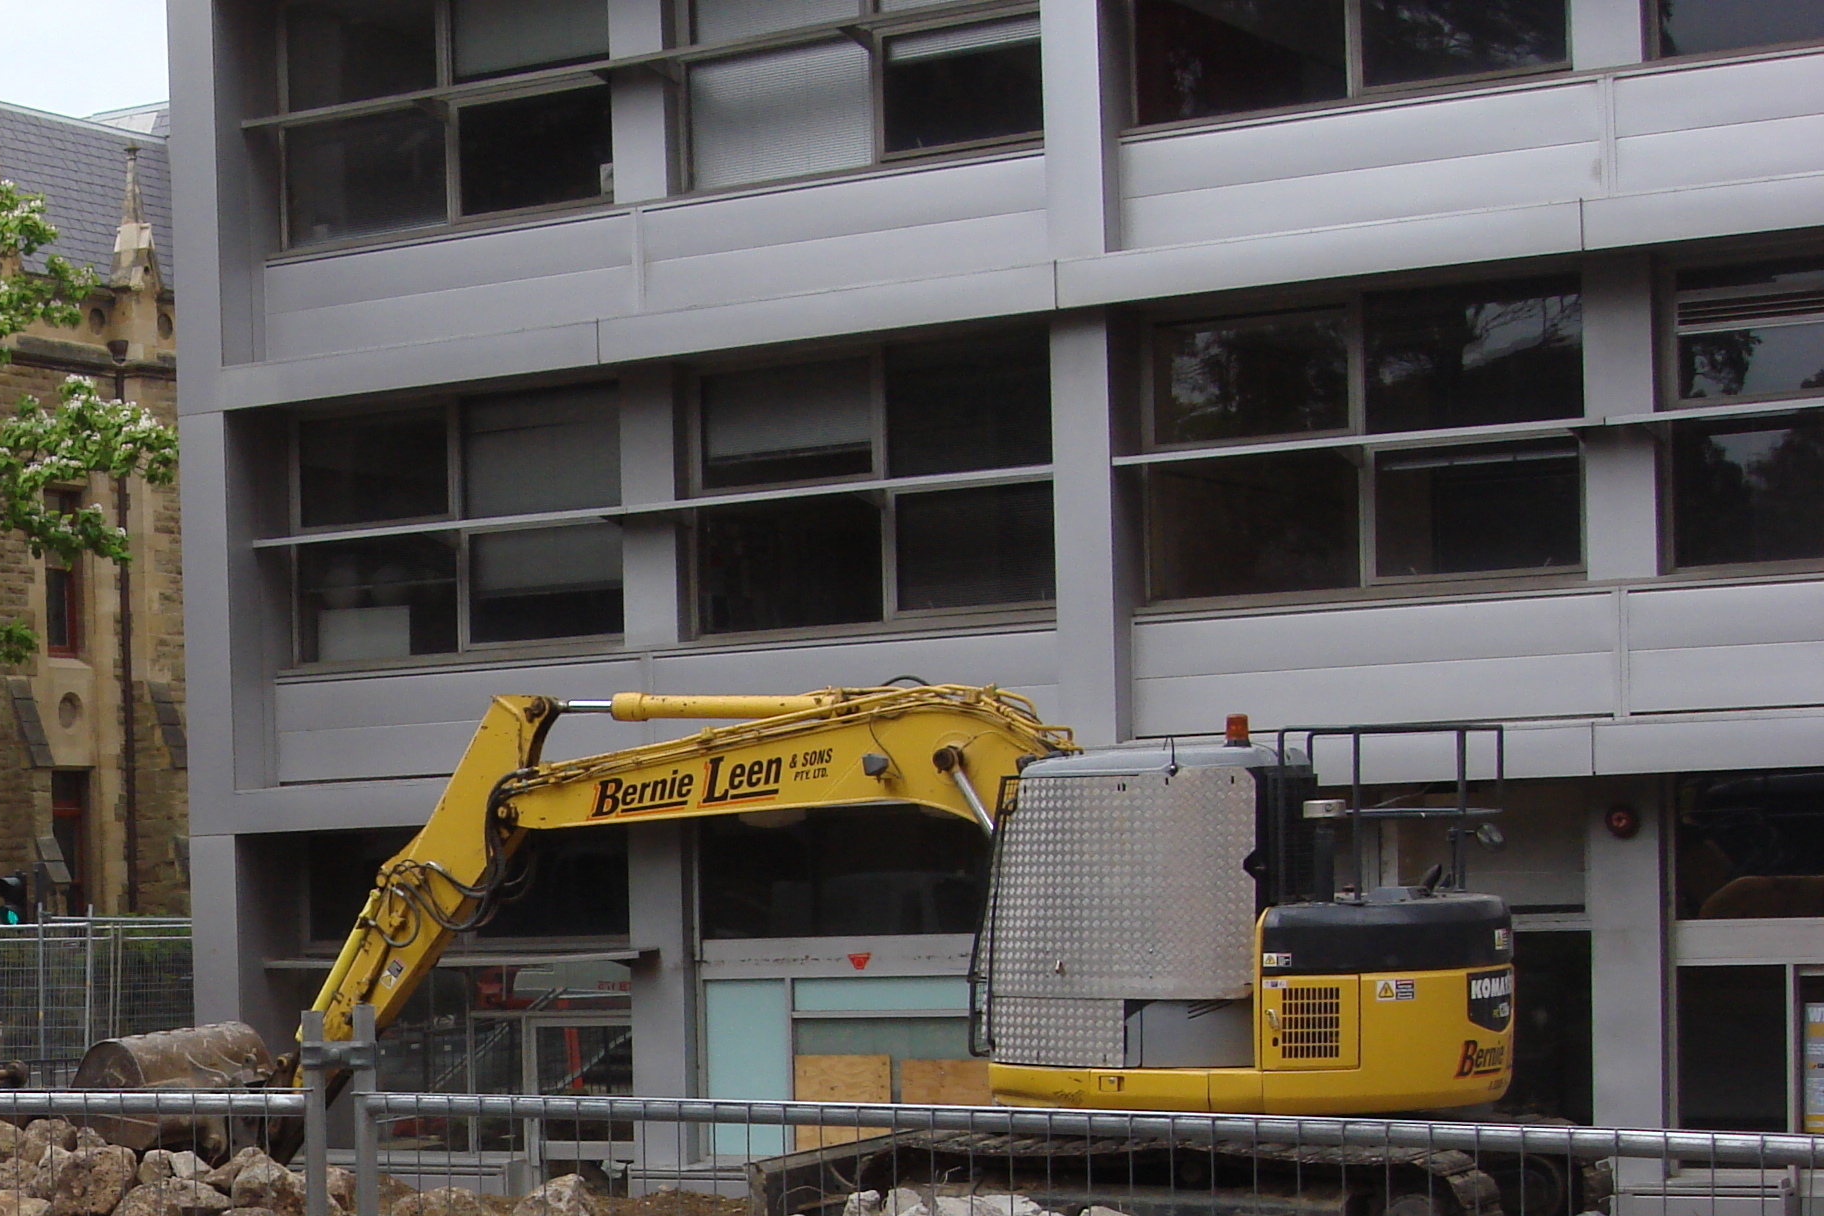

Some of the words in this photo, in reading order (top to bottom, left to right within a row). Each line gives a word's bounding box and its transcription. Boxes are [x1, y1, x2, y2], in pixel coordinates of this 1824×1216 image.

[587, 769, 694, 820] Bernie
[698, 755, 782, 808] Leen
[789, 753, 798, 769] &
[801, 748, 833, 767] SONS
[1454, 1039, 1504, 1079] Bernie
